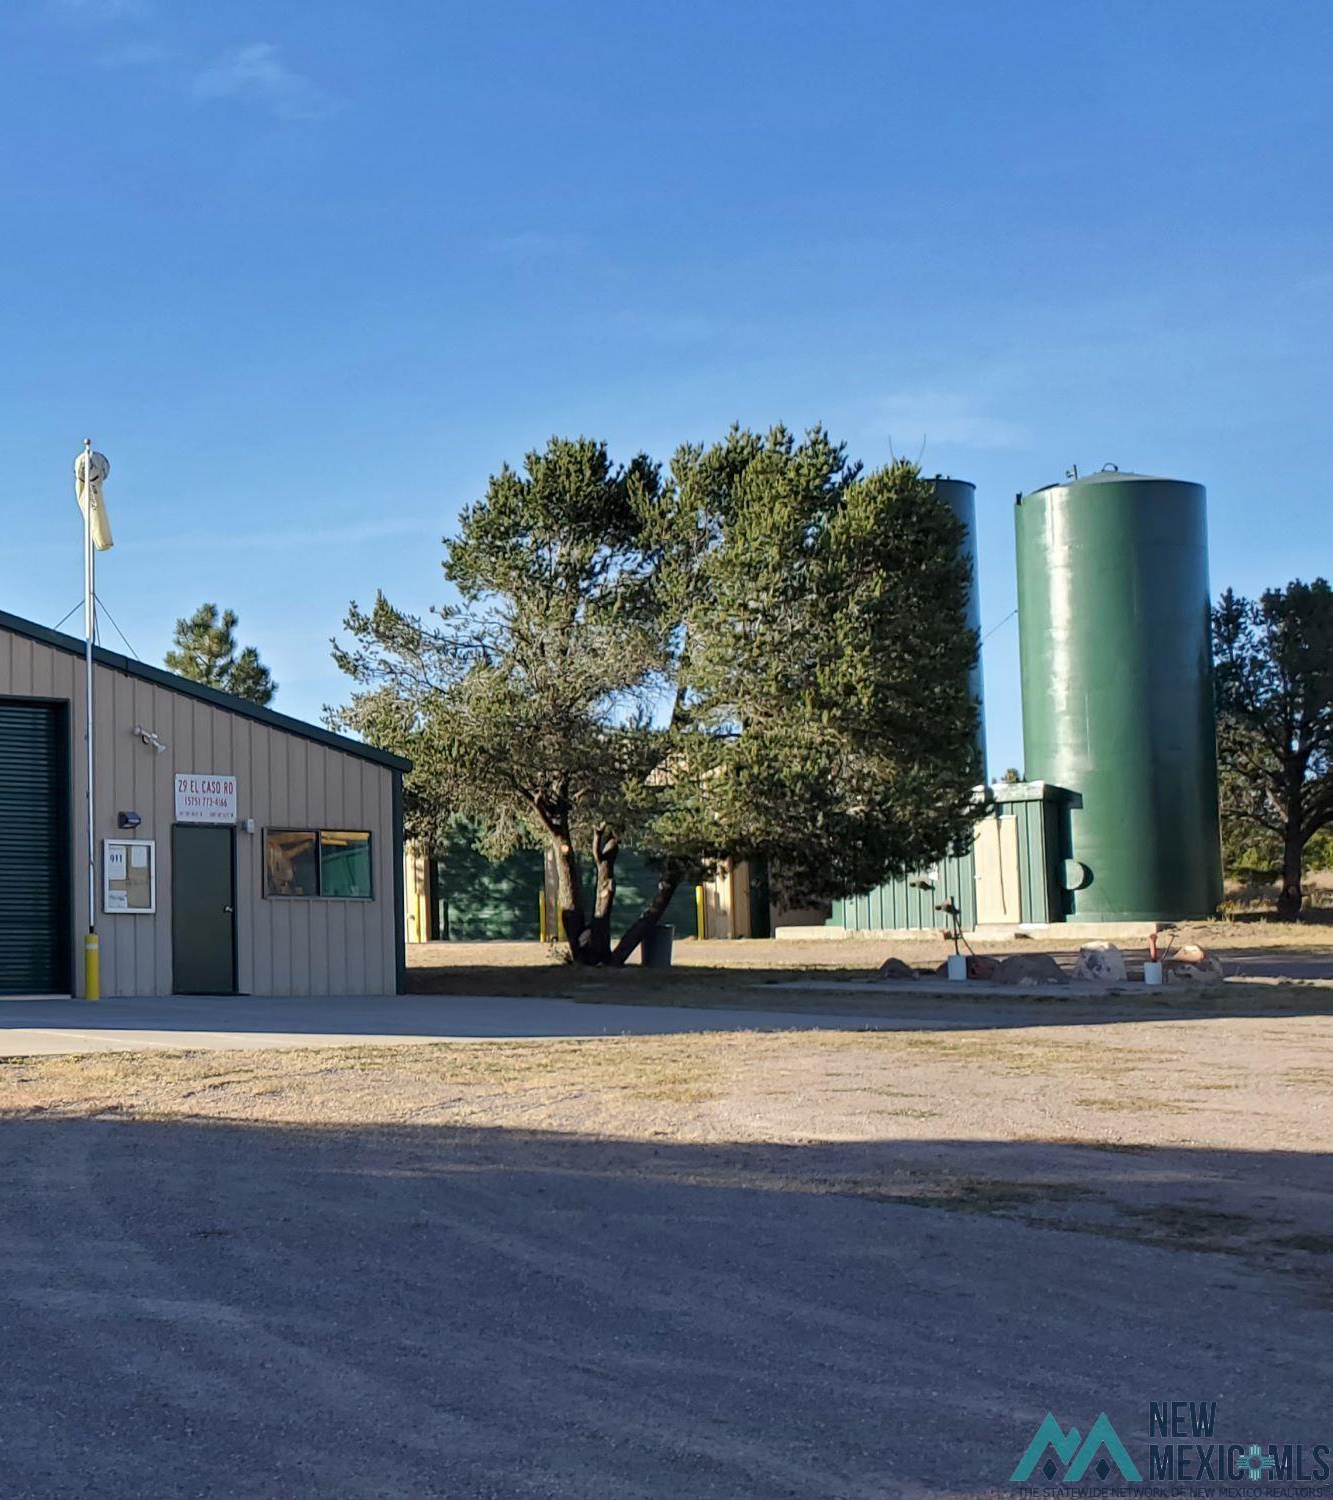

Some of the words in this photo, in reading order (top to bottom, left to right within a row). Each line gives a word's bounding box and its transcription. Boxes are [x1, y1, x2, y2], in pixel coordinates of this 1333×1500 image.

[178, 779, 188, 793] 29
[190, 780, 199, 794] EL
[201, 780, 221, 795] CASO
[223, 781, 234, 796] RD
[109, 854, 123, 863] 911
